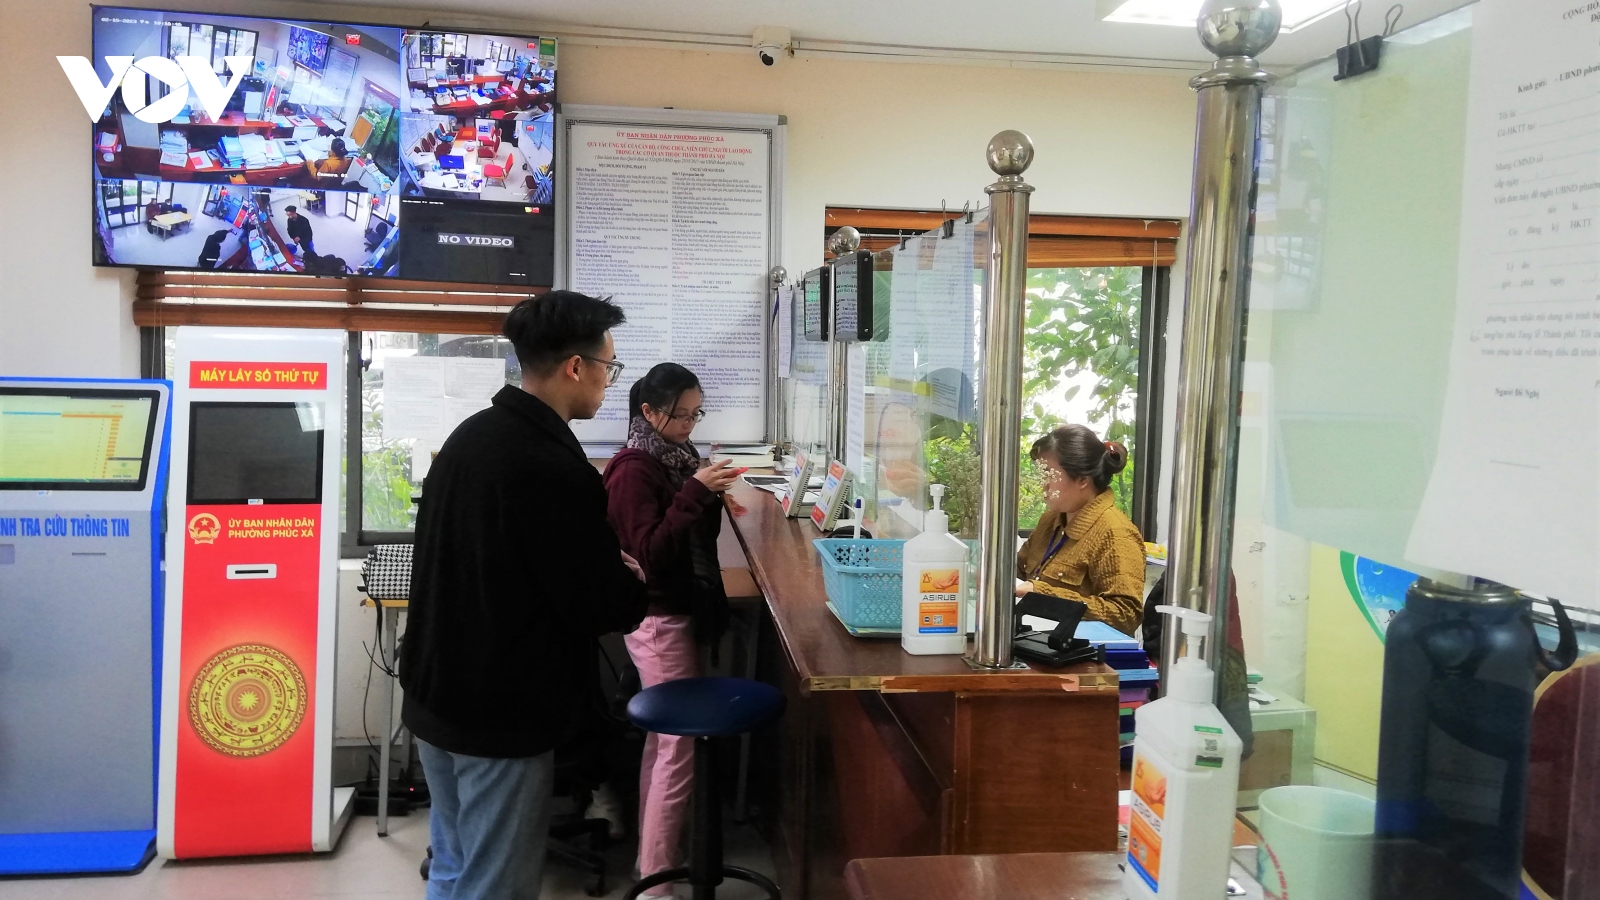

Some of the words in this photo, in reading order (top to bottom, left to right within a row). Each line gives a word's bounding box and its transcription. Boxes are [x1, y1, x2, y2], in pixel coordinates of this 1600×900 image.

[1587, 0, 1600, 12] HÒ
[1559, 68, 1582, 82] UBND
[626, 131, 640, 139] BAN
[438, 234, 461, 244] NO
[464, 236, 513, 247] VIDEO
[200, 367, 227, 382] MÁY
[274, 368, 300, 383] THỨ
[302, 370, 319, 385] TỰ
[19, 517, 41, 537] TRA
[44, 513, 68, 537] CỨU
[70, 513, 108, 537] THÔNG
[110, 517, 130, 537] TIN
[228, 517, 242, 528] ỦY
[243, 519, 264, 528] BAN
[265, 516, 293, 528] NHÂN
[294, 516, 315, 527] DÂN
[228, 528, 271, 539] PHƯỜNG
[272, 527, 299, 538] PHÚC
[300, 527, 315, 538] XÁ
